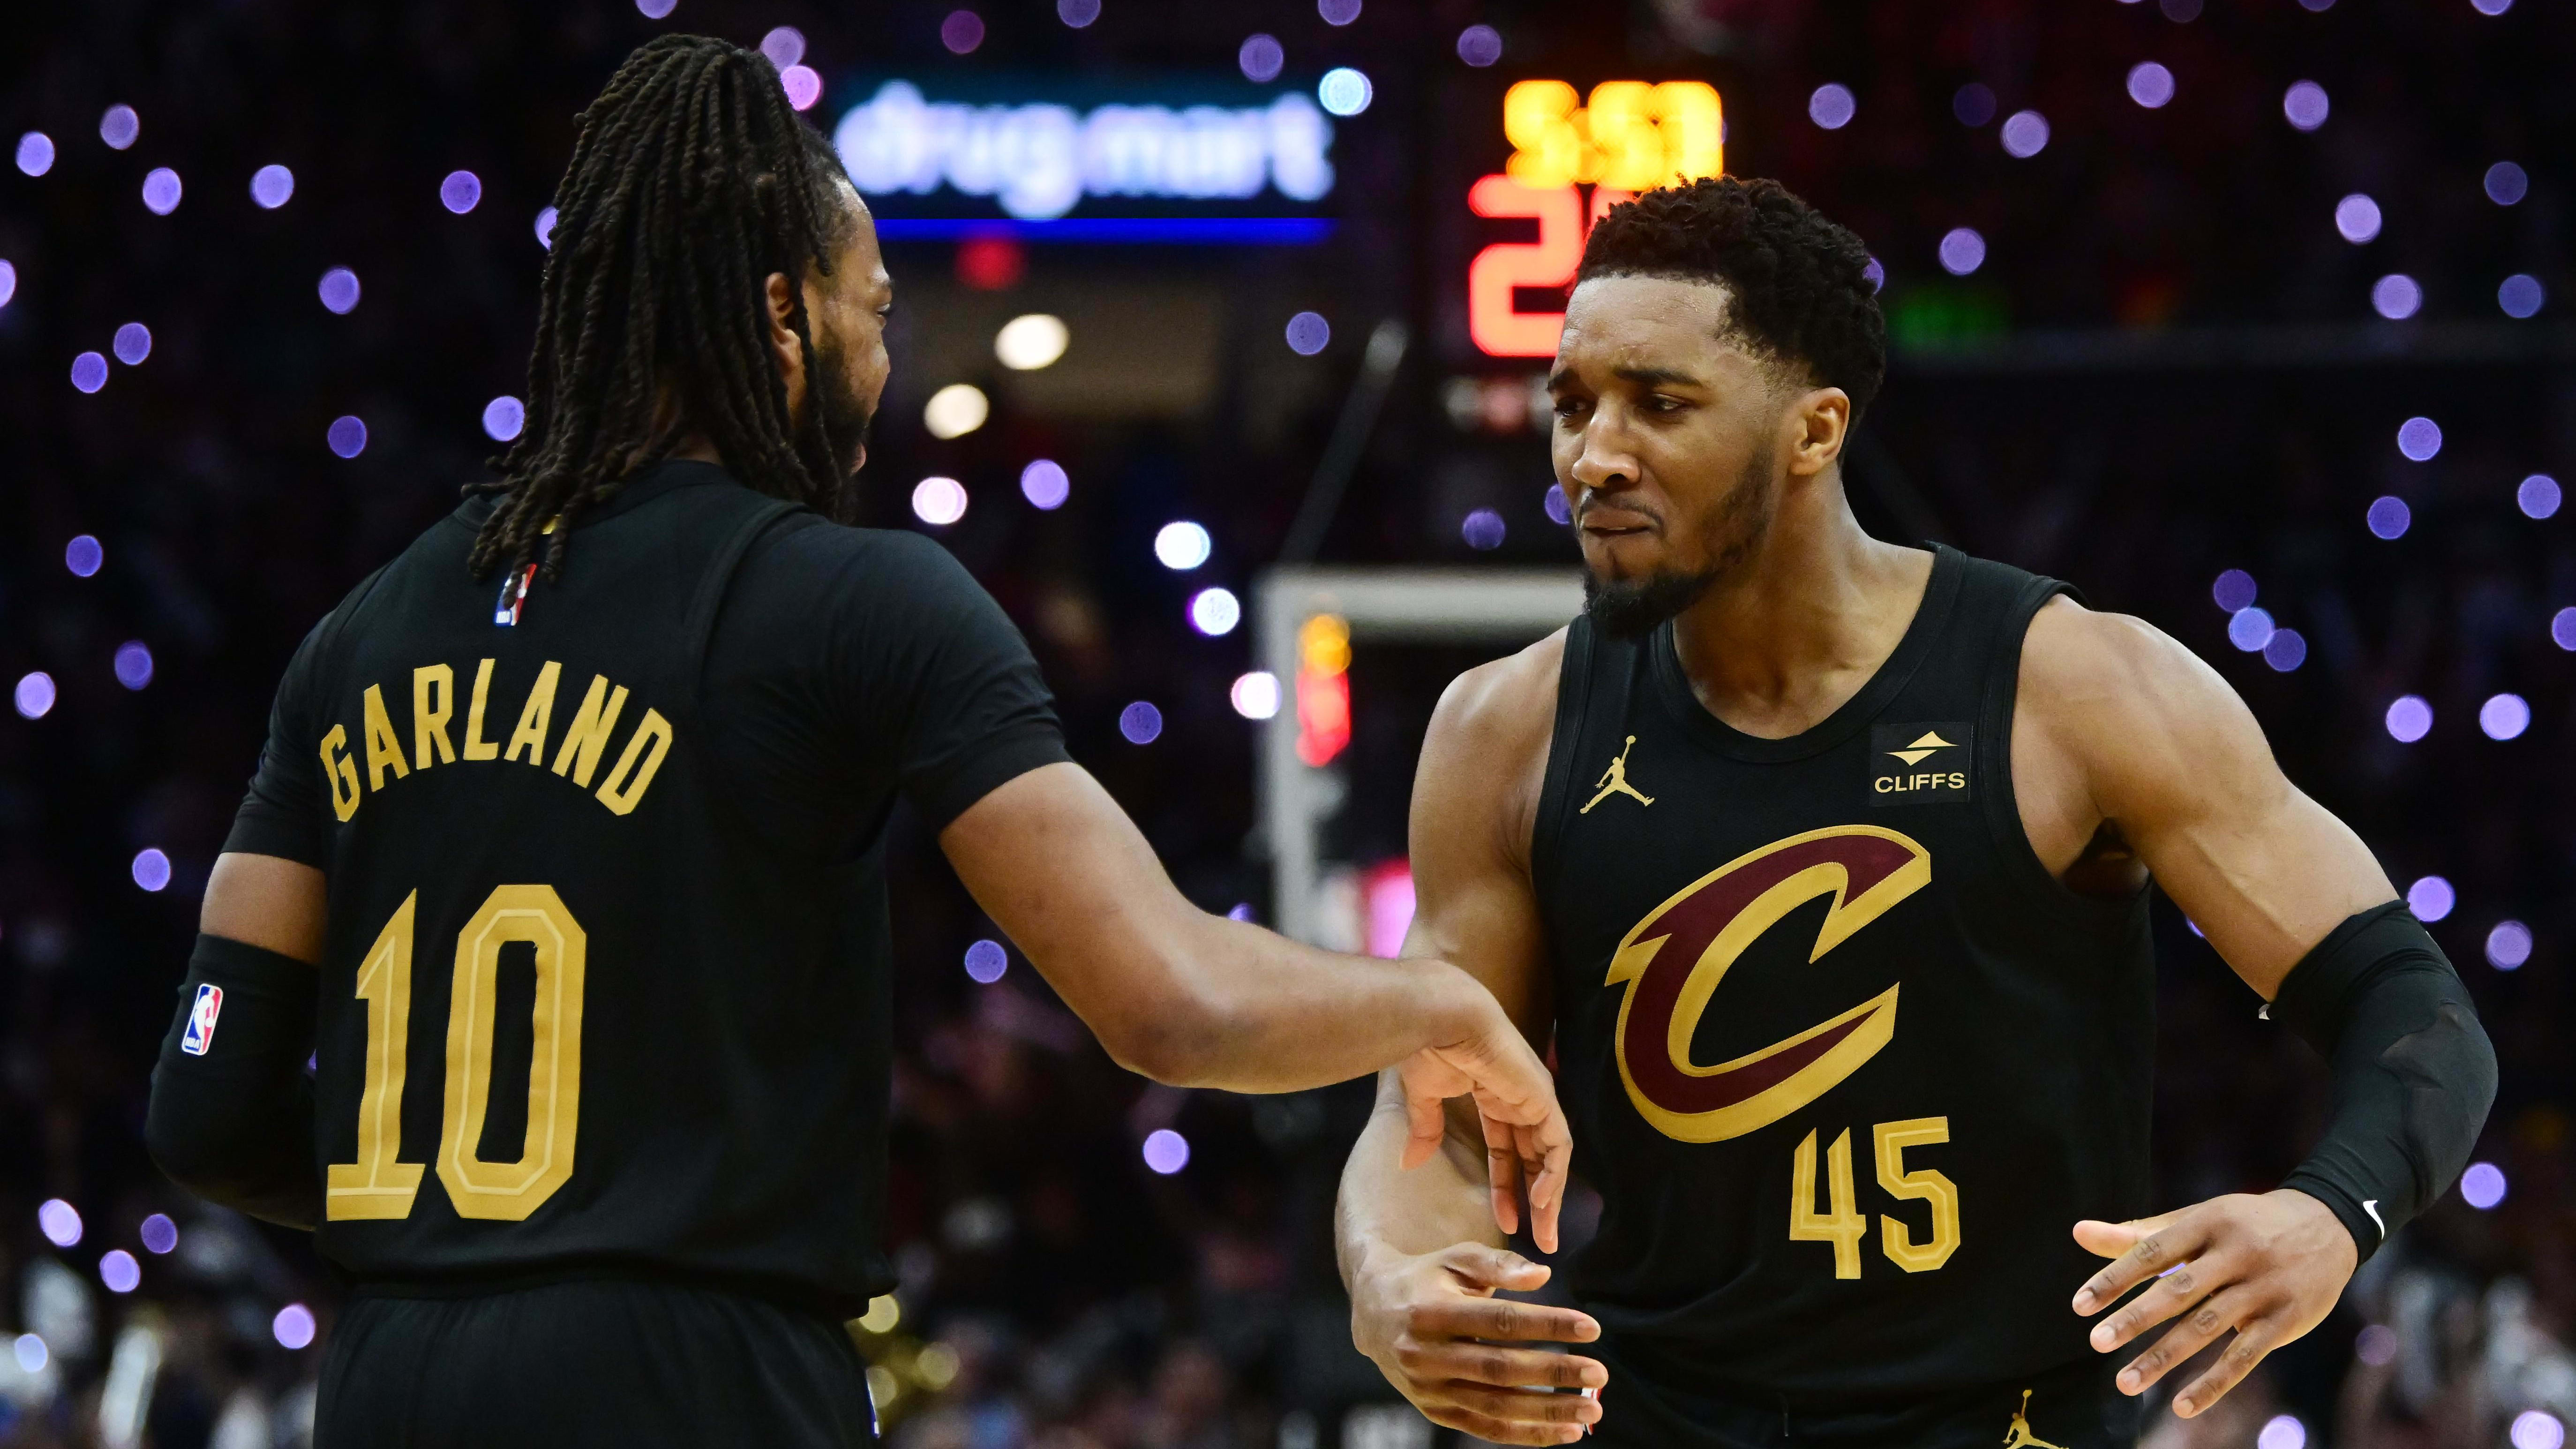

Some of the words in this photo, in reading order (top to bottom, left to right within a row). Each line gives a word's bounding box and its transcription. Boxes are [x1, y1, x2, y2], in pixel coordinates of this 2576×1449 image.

[834, 81, 1081, 220] drug
[1082, 93, 1335, 201] mart
[320, 658, 672, 822] GARLAND
[1875, 772, 1965, 793] CLIFFS
[327, 884, 586, 1221] 10
[1605, 824, 1931, 1143] C
[1789, 1116, 1960, 1279] 45
